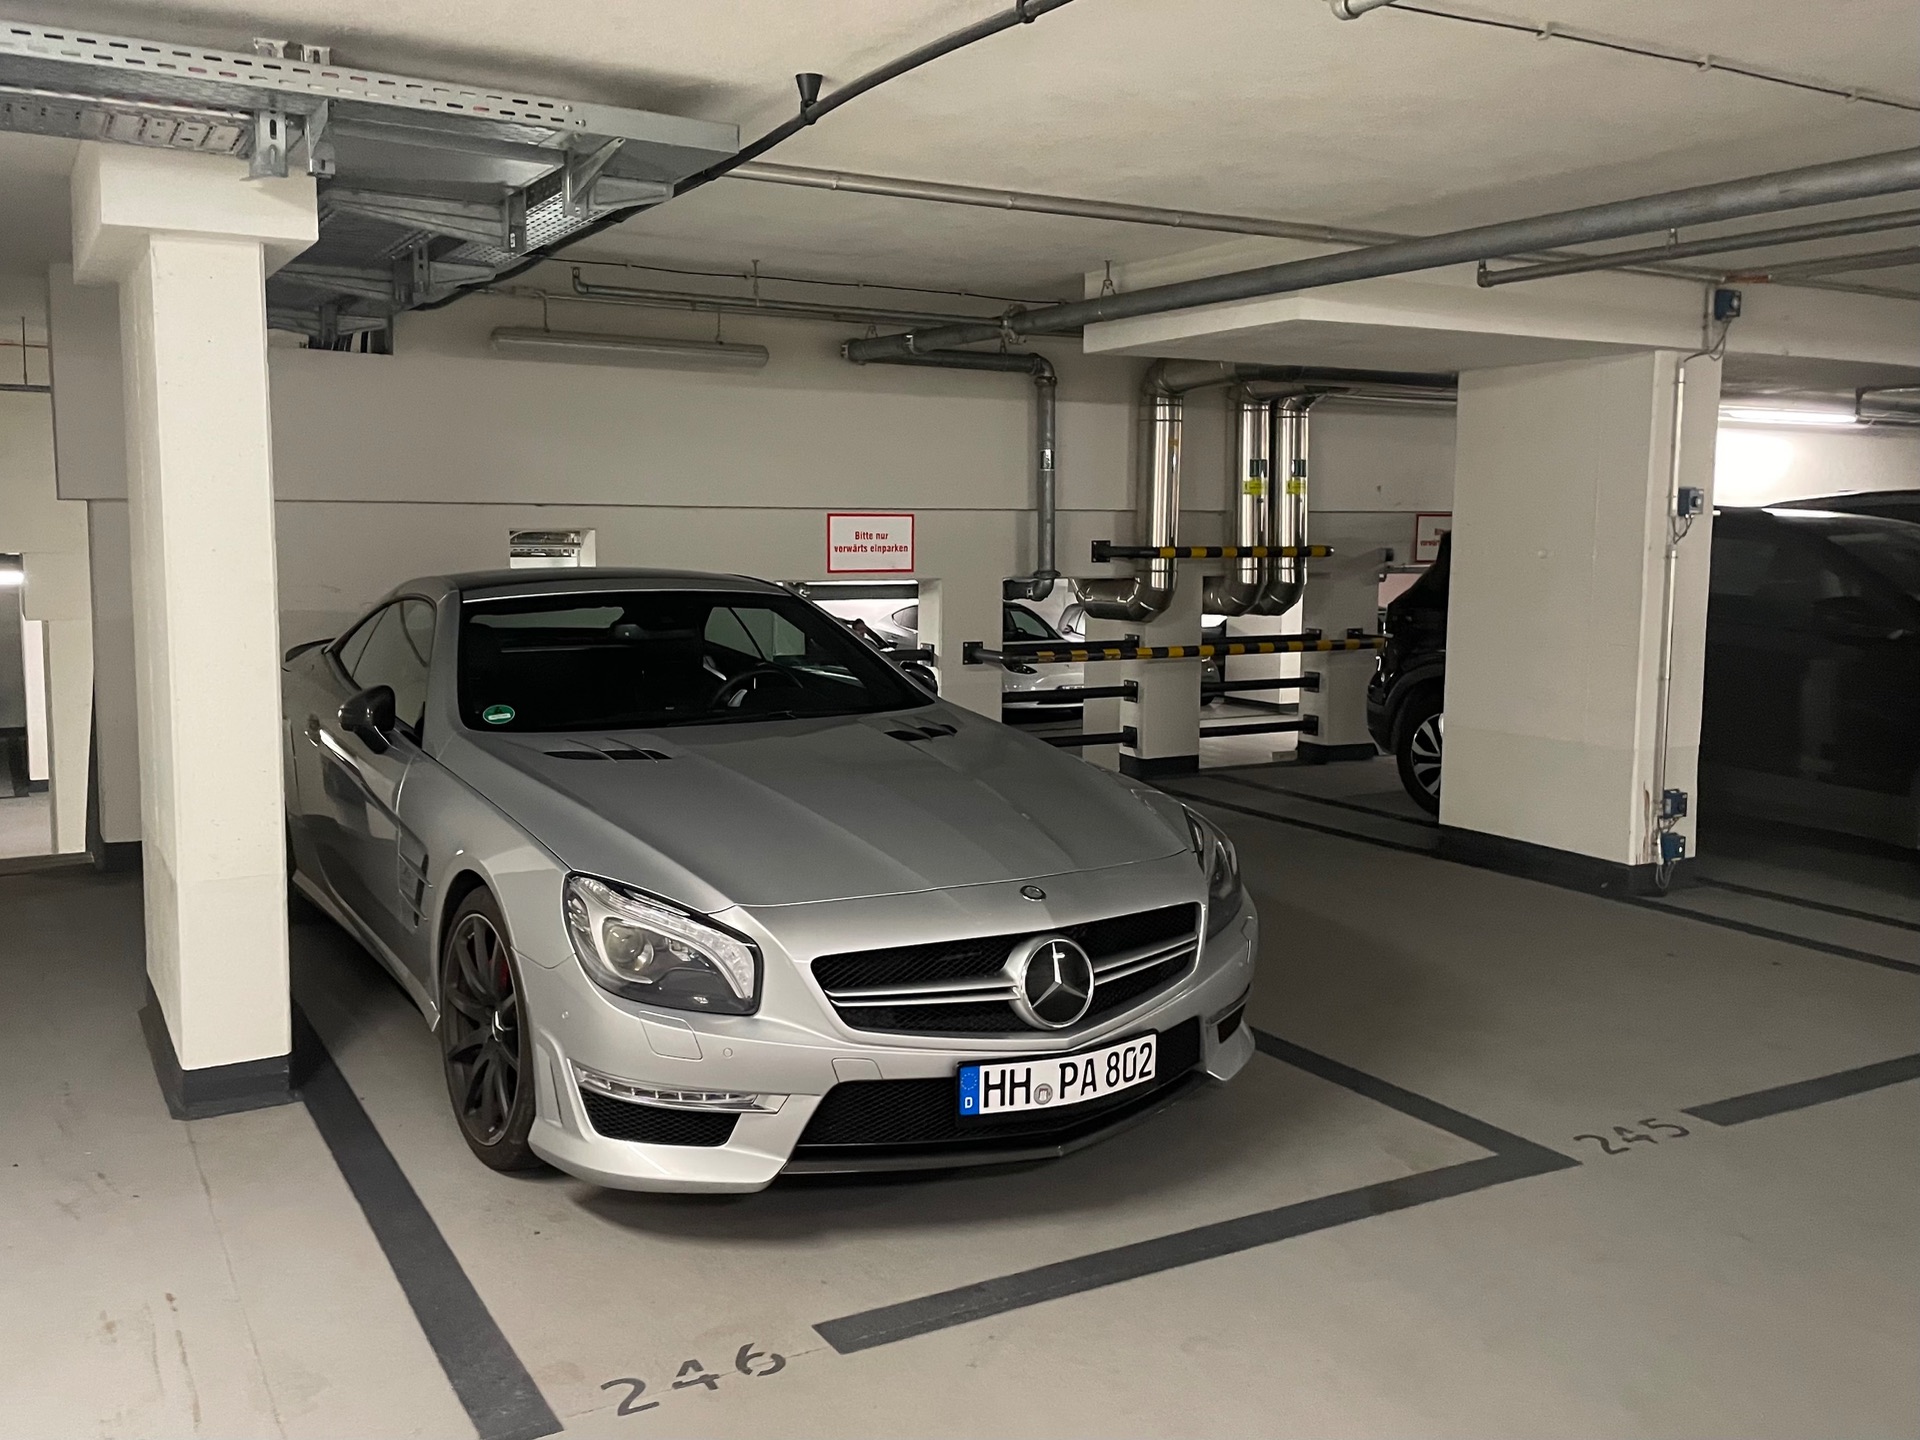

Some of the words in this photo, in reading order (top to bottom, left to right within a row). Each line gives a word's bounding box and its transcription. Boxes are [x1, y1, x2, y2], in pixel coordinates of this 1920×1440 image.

[854, 531, 873, 540] Bitte
[875, 532, 889, 540] nur
[834, 544, 868, 553] vorwärts
[870, 544, 909, 554] einparken
[983, 1067, 1031, 1108] HH
[1059, 1058, 1098, 1099] PA
[1106, 1042, 1153, 1088] 802
[964, 1096, 973, 1109] D
[1573, 1118, 1691, 1155] 245
[600, 1342, 787, 1417] 246
